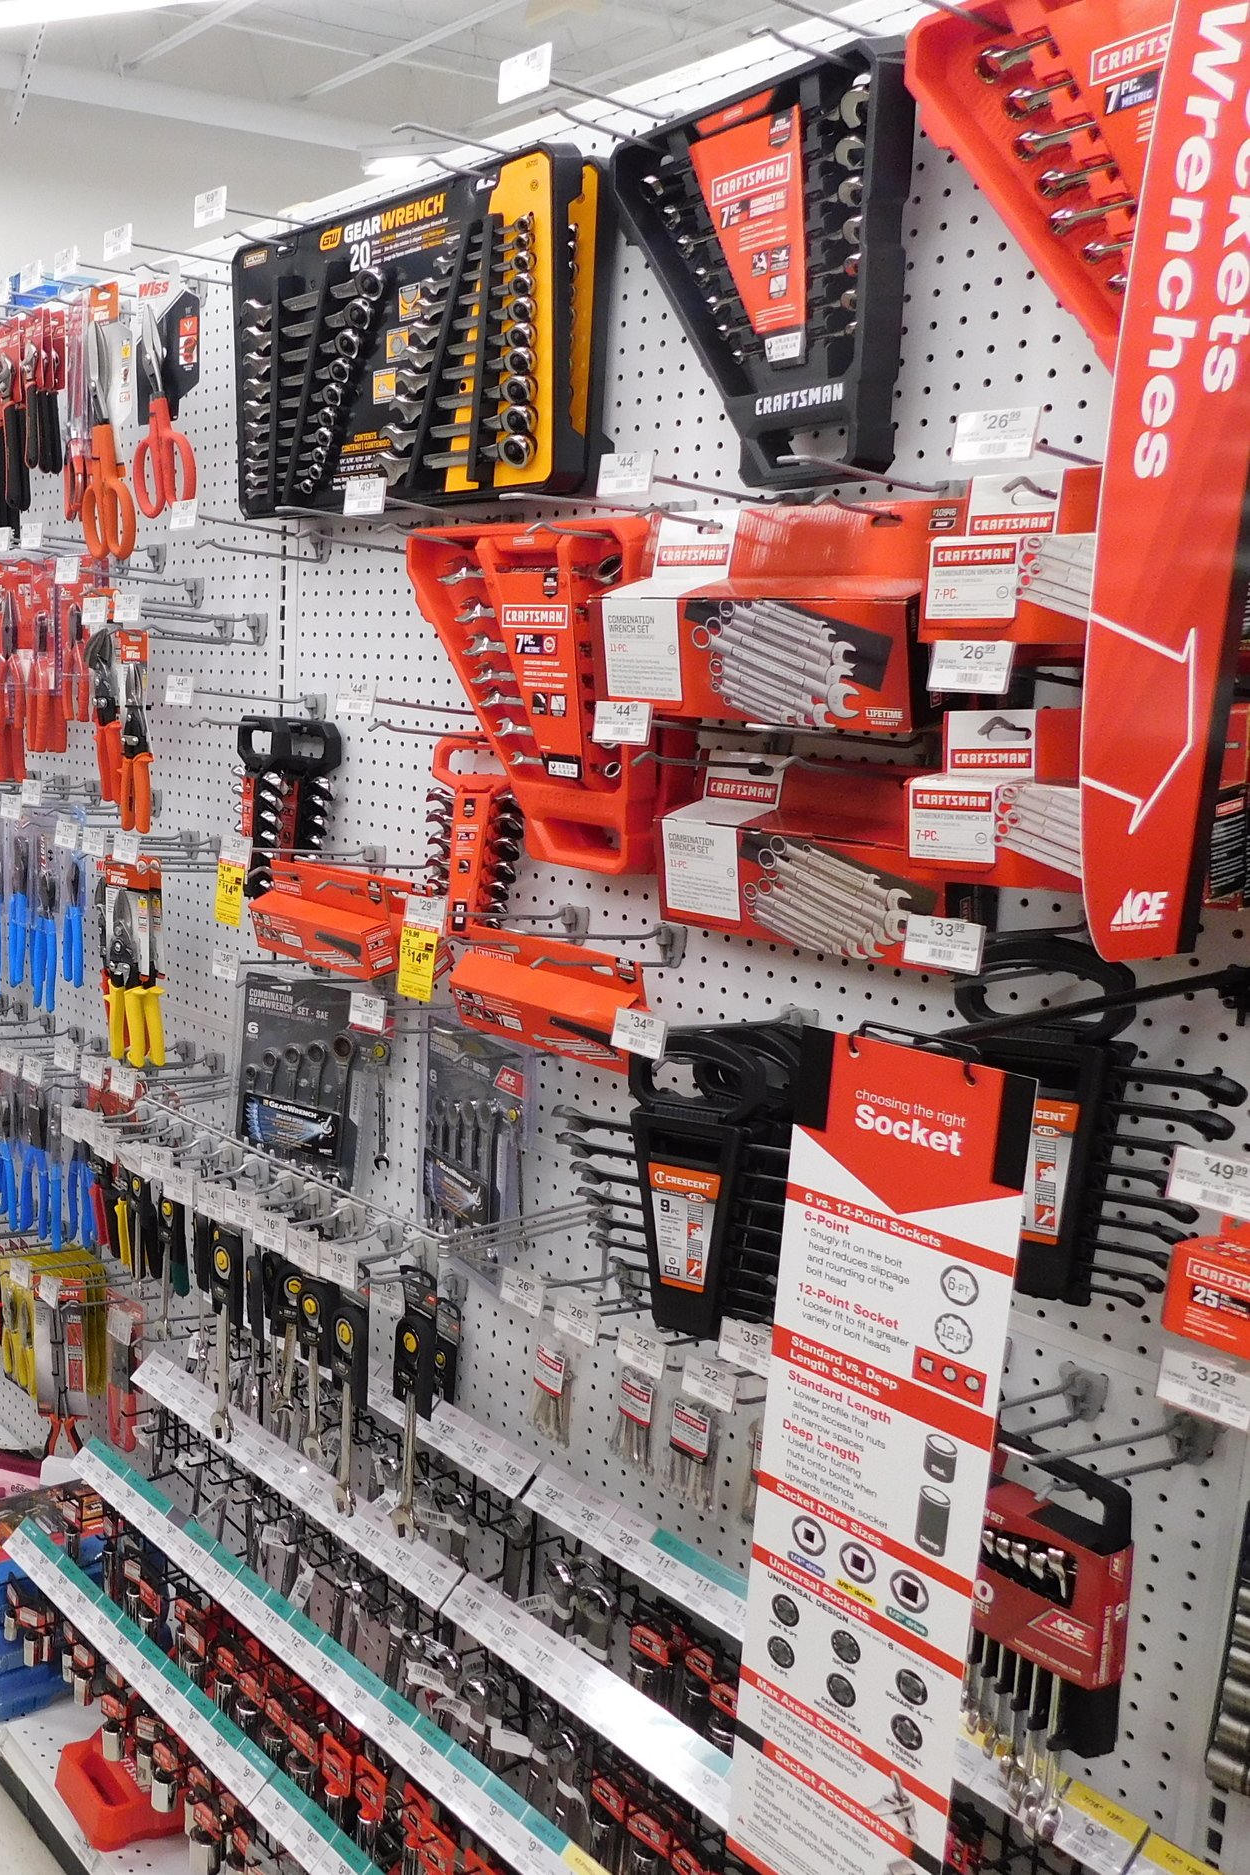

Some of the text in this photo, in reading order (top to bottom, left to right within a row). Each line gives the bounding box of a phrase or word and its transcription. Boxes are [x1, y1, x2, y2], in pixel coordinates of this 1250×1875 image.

[1099, 33, 1170, 75] CRAFTS
[1105, 77, 1141, 114] 7 PC.
[716, 161, 787, 198] CRAFTSMAN
[344, 192, 447, 243] GEARWRENCH
[721, 205, 730, 229] 7
[350, 240, 371, 272] 20
[1134, 3, 1248, 479] Wrenches
[1203, 87, 1250, 393] ckets
[755, 382, 844, 416] CRAFTSMAN
[973, 515, 1053, 532] CRAFTSMAN
[658, 547, 727, 564] CRAFTSMAN
[937, 545, 1015, 563] CRAFTSMAN
[505, 609, 564, 623] CRAFTSMAN
[607, 615, 655, 625] COMBINATION
[608, 624, 649, 634] WRENCH SET
[516, 634, 524, 654] 7
[865, 708, 903, 720] LIFETIME
[954, 751, 1030, 766] CRAFTSMAN
[710, 781, 776, 799] CRAFTSMAN
[916, 793, 990, 808] CRAFTSMAN
[668, 832, 715, 848] COMBINATION
[668, 841, 710, 855] WRENCH SET
[1111, 888, 1169, 923] ACE
[248, 996, 293, 1013] GEARWRENCH
[297, 1007, 310, 1017] SET
[315, 1010, 329, 1021] SAE
[249, 988, 293, 1005] COMBINATION
[247, 1021, 259, 1034] 6
[855, 1088, 966, 1128] choosing the right
[1035, 1109, 1066, 1123] CENT
[854, 1105, 963, 1156] Socket
[665, 1174, 711, 1191] CRESCENT
[660, 1198, 670, 1213] 9
[804, 1192, 942, 1248] 6 vs. 12-Point Sockets
[804, 1210, 850, 1235] 6-Point
[808, 1241, 910, 1285] head reduces slippage
[810, 1228, 903, 1269] Snugly fit on the bolt
[805, 1265, 847, 1288] bolt head
[807, 1254, 894, 1293] and rounding of the
[947, 1276, 971, 1297] 6-PT.
[1193, 1265, 1250, 1290] CRAFTSM
[798, 1282, 899, 1331] 12-Point Socket
[1193, 1285, 1220, 1309] 25
[801, 1312, 891, 1354] variety of bolt heads
[803, 1297, 832, 1315] Looser
[834, 1308, 843, 1320] fit
[845, 1314, 855, 1324] to
[856, 1317, 866, 1328] fit
[876, 1329, 909, 1348] greater
[790, 1336, 899, 1391] Standard vs. Deep
[790, 1348, 881, 1397] Length Sockets
[788, 1370, 891, 1425] Standard Length
[793, 1387, 869, 1428] Lower profile that
[782, 1418, 861, 1464] Deep Length
[791, 1411, 865, 1452] in narrow spaces
[792, 1401, 886, 1450] allows access to nuts
[786, 1447, 877, 1499] nuts onto bolts when
[787, 1435, 862, 1479] Useful for turning
[785, 1458, 855, 1500] the bolt extends
[776, 1482, 883, 1548] Socket Drive Sizes
[784, 1472, 888, 1531] upwards into the socket
[767, 1571, 849, 1624] UNIVERSAL DESIGN
[768, 1555, 870, 1621] Universal Sockets
[1050, 1619, 1086, 1641] ACE
[756, 1678, 780, 1701] Max
[781, 1693, 814, 1722] Axess
[816, 1718, 863, 1755] Sockets
[774, 1750, 817, 1787] Socket
[818, 1780, 897, 1843] Accessories
